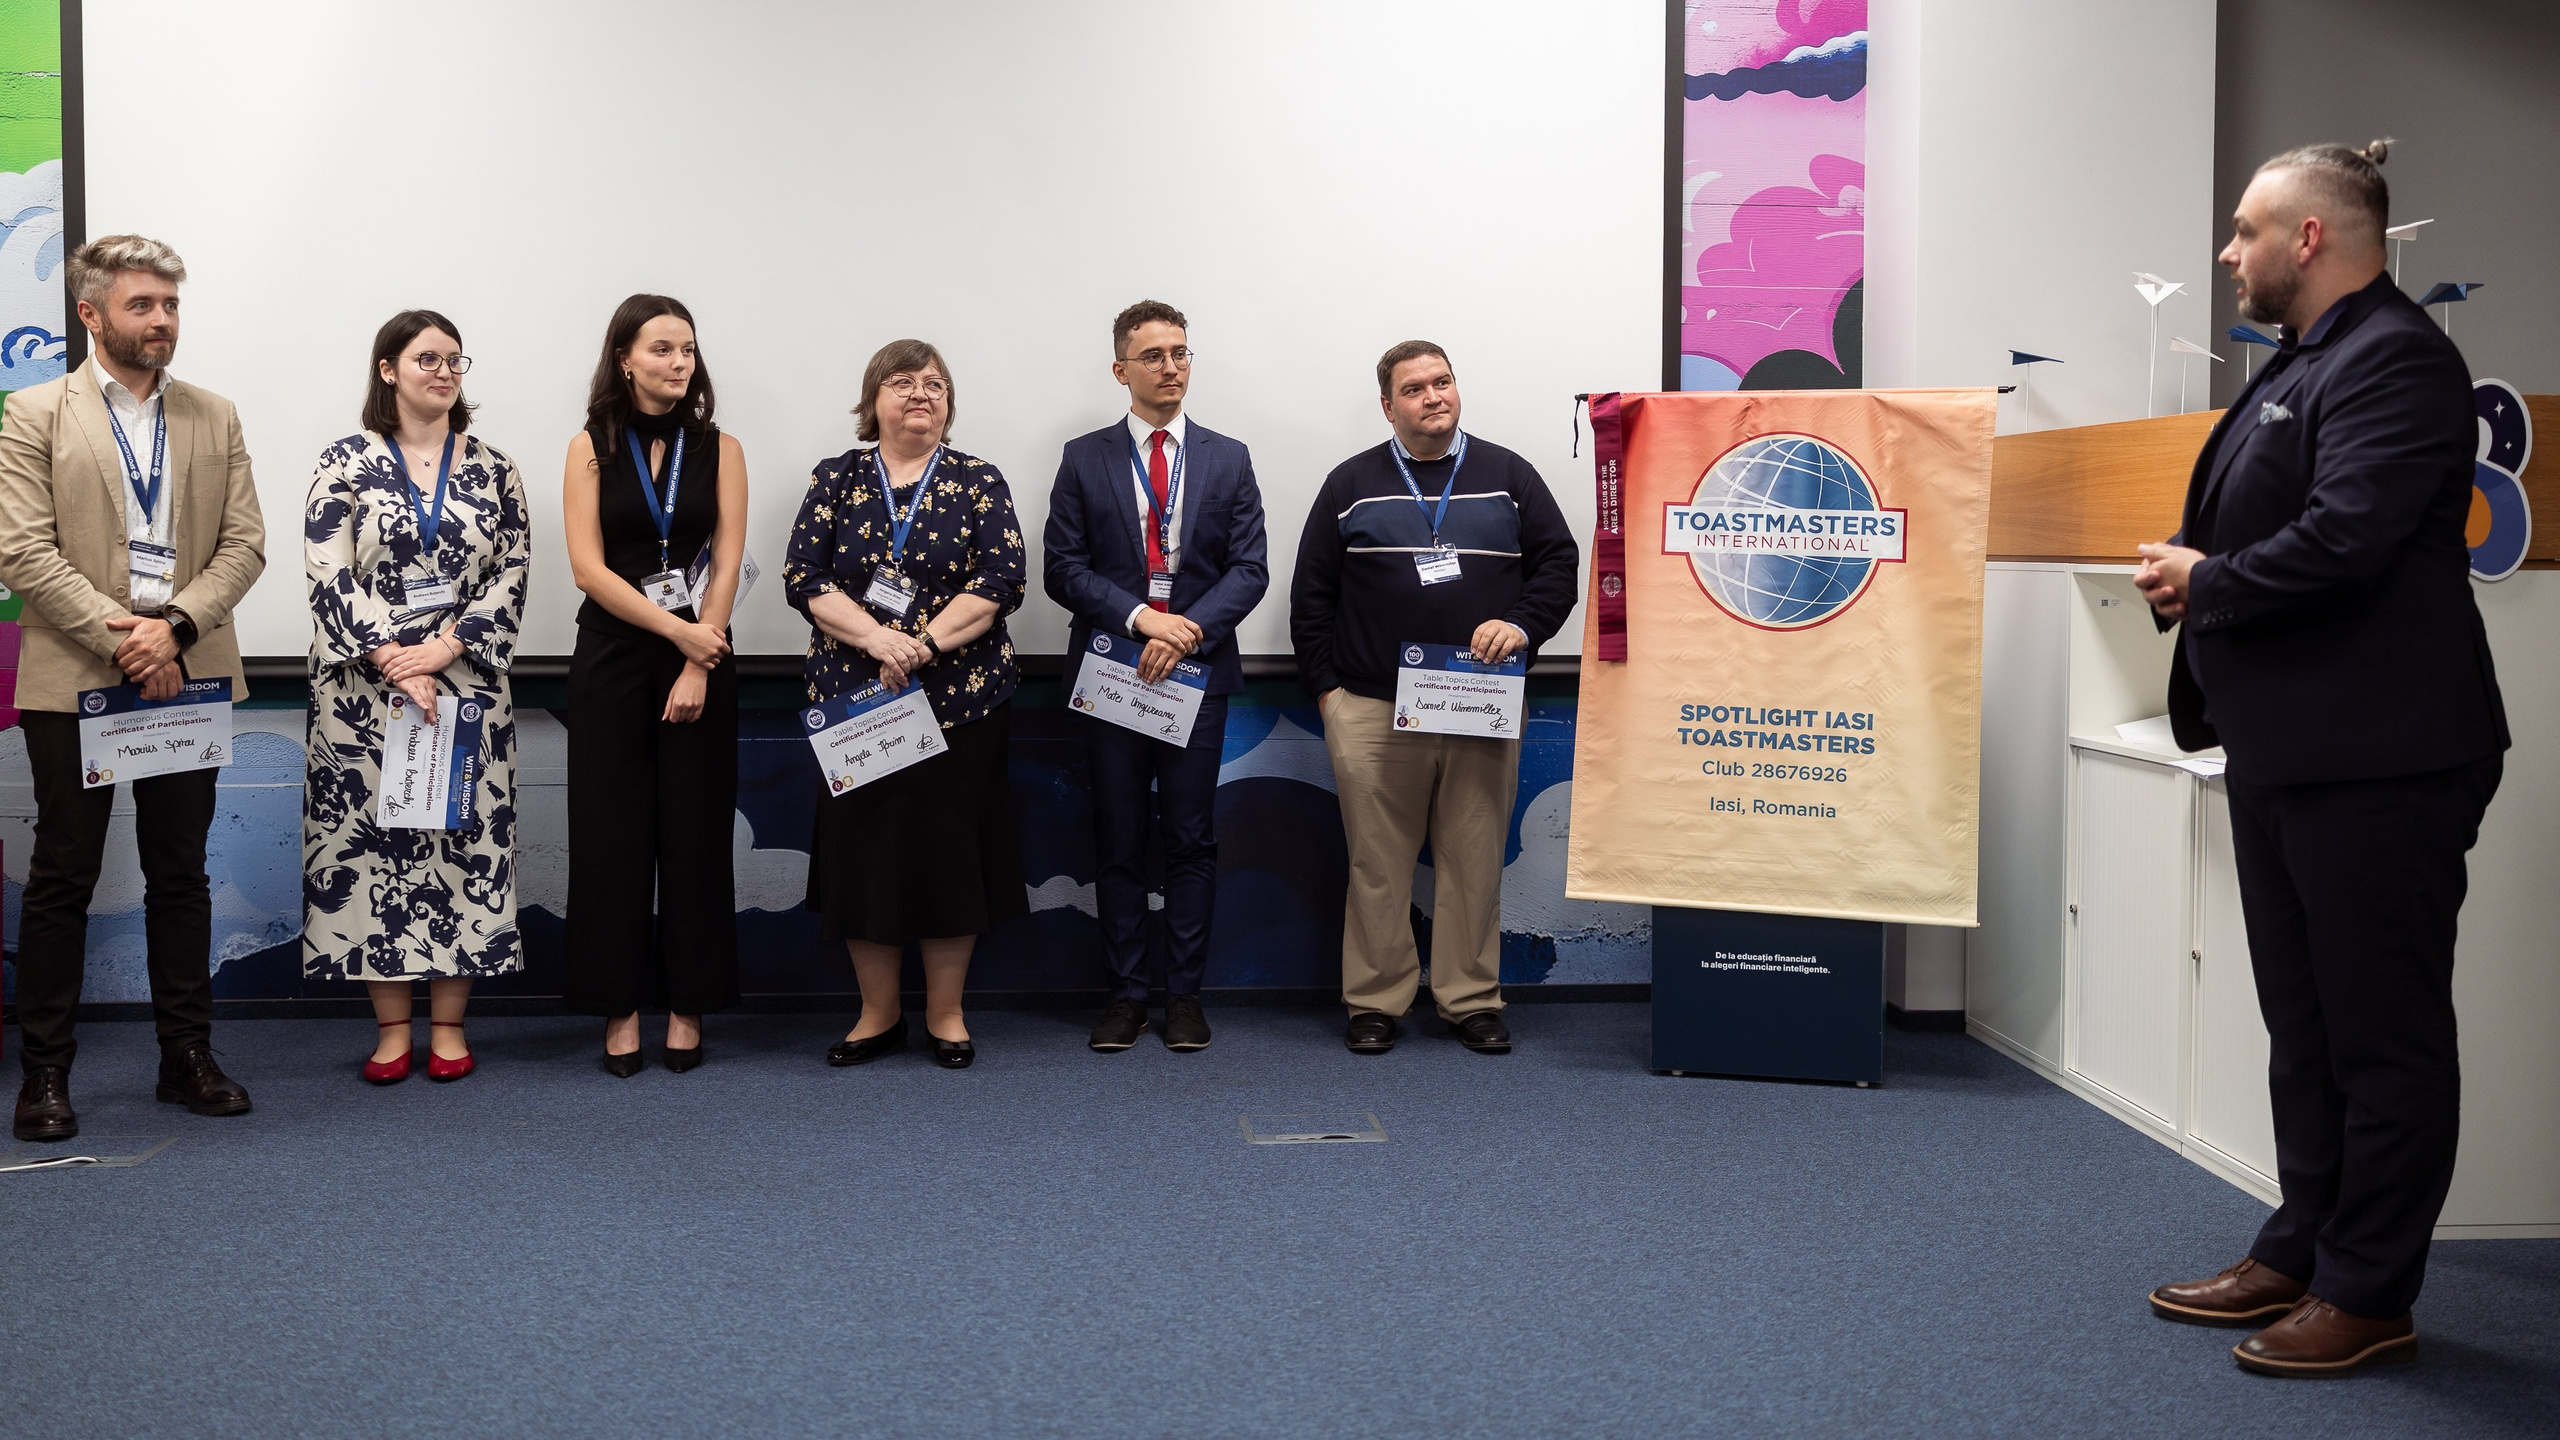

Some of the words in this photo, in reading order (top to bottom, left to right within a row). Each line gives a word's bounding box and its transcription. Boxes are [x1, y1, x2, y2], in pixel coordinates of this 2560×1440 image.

[1602, 479, 1608, 490] OF
[1610, 508, 1618, 534] AREA
[1674, 511, 1896, 536] TOASTMASTERS
[1696, 534, 1869, 552] INTERNATIONAL
[1106, 664, 1126, 676] Table
[1445, 676, 1469, 684] Topics
[1471, 678, 1500, 686] Contest
[850, 683, 884, 702] WIT&WI
[1096, 670, 1132, 685] Certificate
[1141, 685, 1184, 703] Participation
[1414, 682, 1451, 690] Certificate
[1462, 686, 1507, 695] Participation
[100, 725, 145, 738] Certificate
[158, 716, 212, 729] Participation
[113, 714, 162, 727] Humorous
[163, 710, 199, 719] Contest
[833, 725, 853, 738] Table
[853, 716, 876, 729] Topics
[877, 704, 905, 719] Contest
[1680, 704, 1818, 727] SPOTLIGHT
[1825, 711, 1874, 730] IASI
[830, 731, 864, 748] Certificate
[872, 709, 915, 730] Participation
[439, 726, 449, 768] Humorous
[1678, 728, 1875, 755] TOASTMASTERS
[1702, 760, 1744, 776] Club
[1751, 763, 1847, 782] 28676926
[426, 763, 436, 810] Participation
[436, 769, 445, 799] Contest
[1710, 796, 1746, 815] Iasi,
[1753, 799, 1836, 818] Romania
[1710, 961, 1738, 970] alegeri
[1740, 962, 1782, 972] financiare
[1783, 964, 1831, 974] inteligente.
[1774, 954, 1817, 963] financiară
